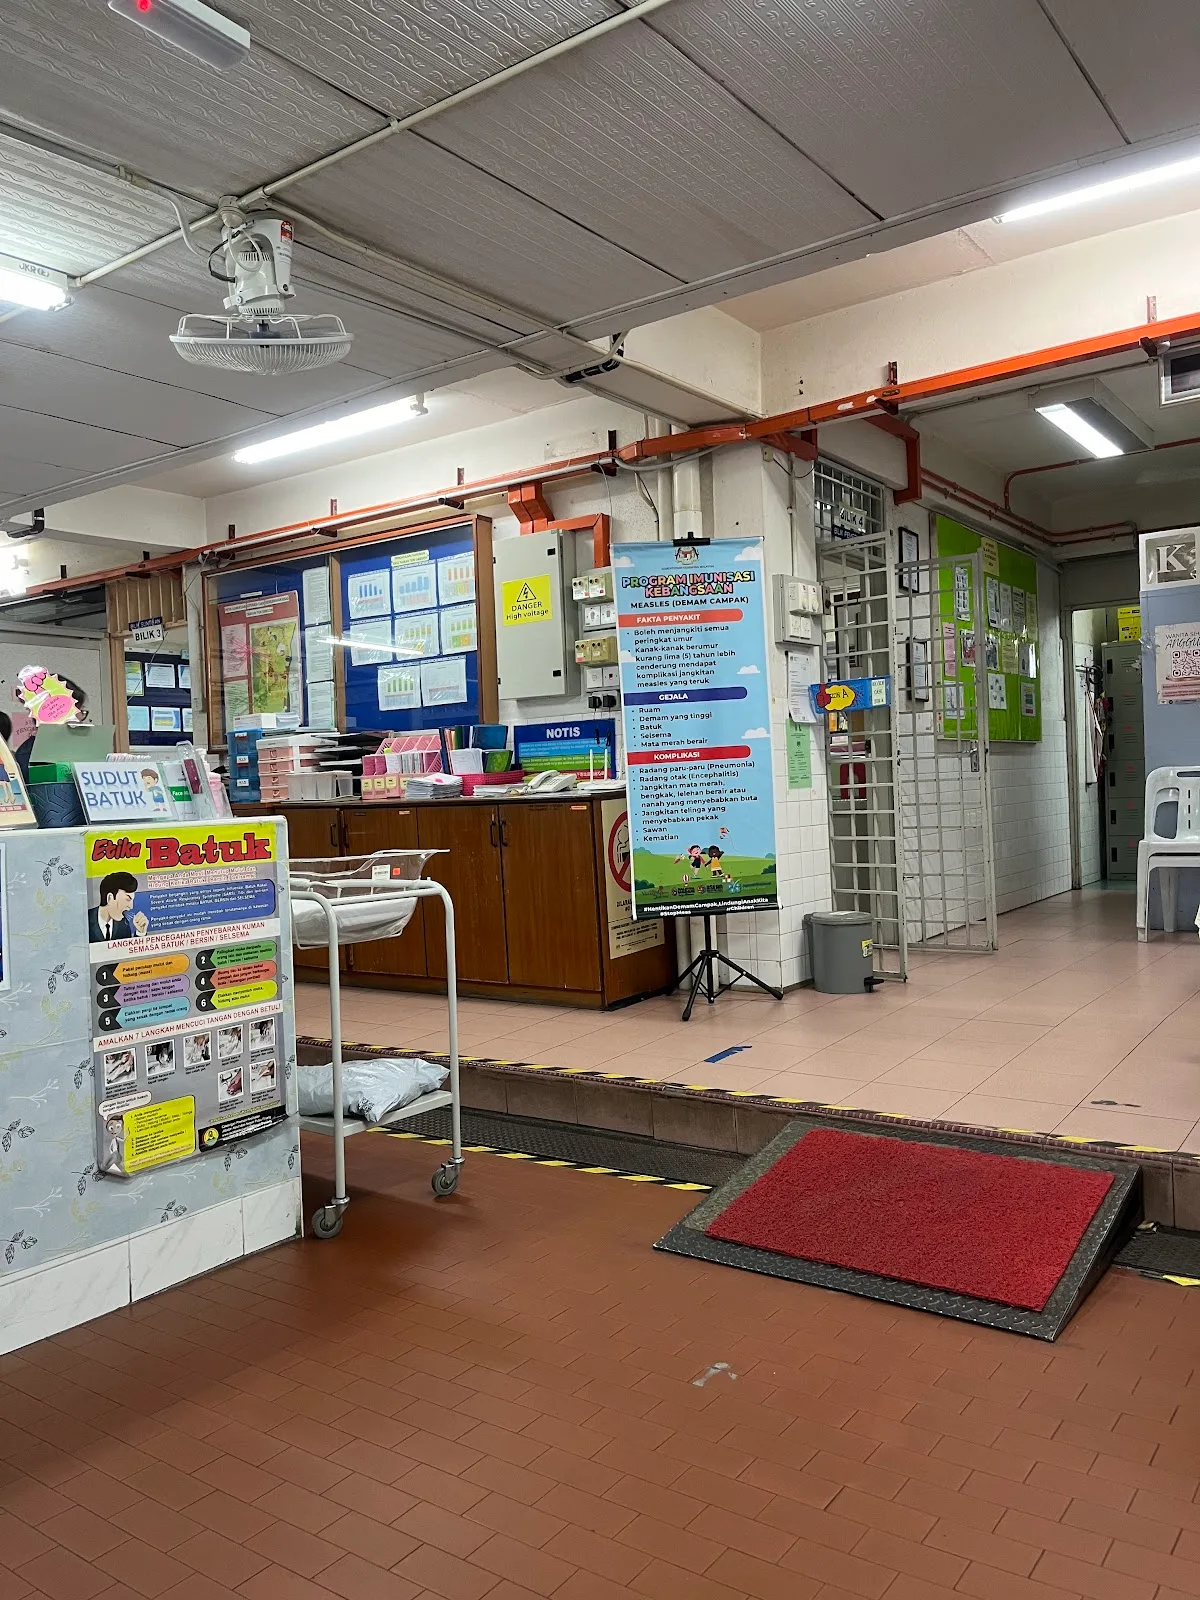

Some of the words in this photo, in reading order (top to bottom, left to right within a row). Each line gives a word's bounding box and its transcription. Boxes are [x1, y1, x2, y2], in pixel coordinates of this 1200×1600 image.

[622, 574, 686, 588] PROGRAM
[689, 571, 755, 584] IMUNISASI
[645, 584, 733, 598] KEBANGSAAN
[512, 601, 542, 611] DANGER
[673, 597, 706, 607] (DEMAM
[664, 614, 700, 622] PENYAKIT
[135, 630, 154, 641] BILIK
[157, 629, 160, 637] 3
[658, 626, 702, 634] menjangkiti
[1165, 636, 1200, 650] ANGGU
[637, 671, 677, 680] komplikasi
[680, 669, 714, 677] jangkitan
[842, 689, 848, 698] A
[546, 727, 580, 739] NOTIS
[654, 752, 700, 760] KOMPLIKASI
[707, 761, 755, 770] (Pneumonia)
[81, 771, 137, 786] SUDUT
[689, 771, 738, 780] (Encephalitis)
[86, 790, 146, 807] BATUK
[687, 797, 738, 805] menyebabkan
[643, 816, 694, 825] menyebabkan
[92, 837, 142, 861] Etika
[146, 832, 272, 869] Batuk
[107, 939, 144, 949] LANGKAH
[146, 932, 195, 944] PENCEGAHAN
[197, 925, 240, 936] PENYEBARAN
[242, 922, 265, 931] KUMAN
[128, 945, 159, 954] SEMASA
[161, 941, 184, 949] BATUK
[191, 936, 214, 944] BERSIN
[219, 932, 250, 940] SELSEMA
[102, 972, 106, 980] 1
[103, 994, 108, 1002] 3
[105, 1017, 110, 1025] 5
[98, 1035, 134, 1047] AMALKAN
[141, 1026, 174, 1037] LANGKAH
[176, 1020, 206, 1032] MENCUCI
[207, 1014, 232, 1025] TANGAN
[234, 1009, 259, 1020] DENGAN
